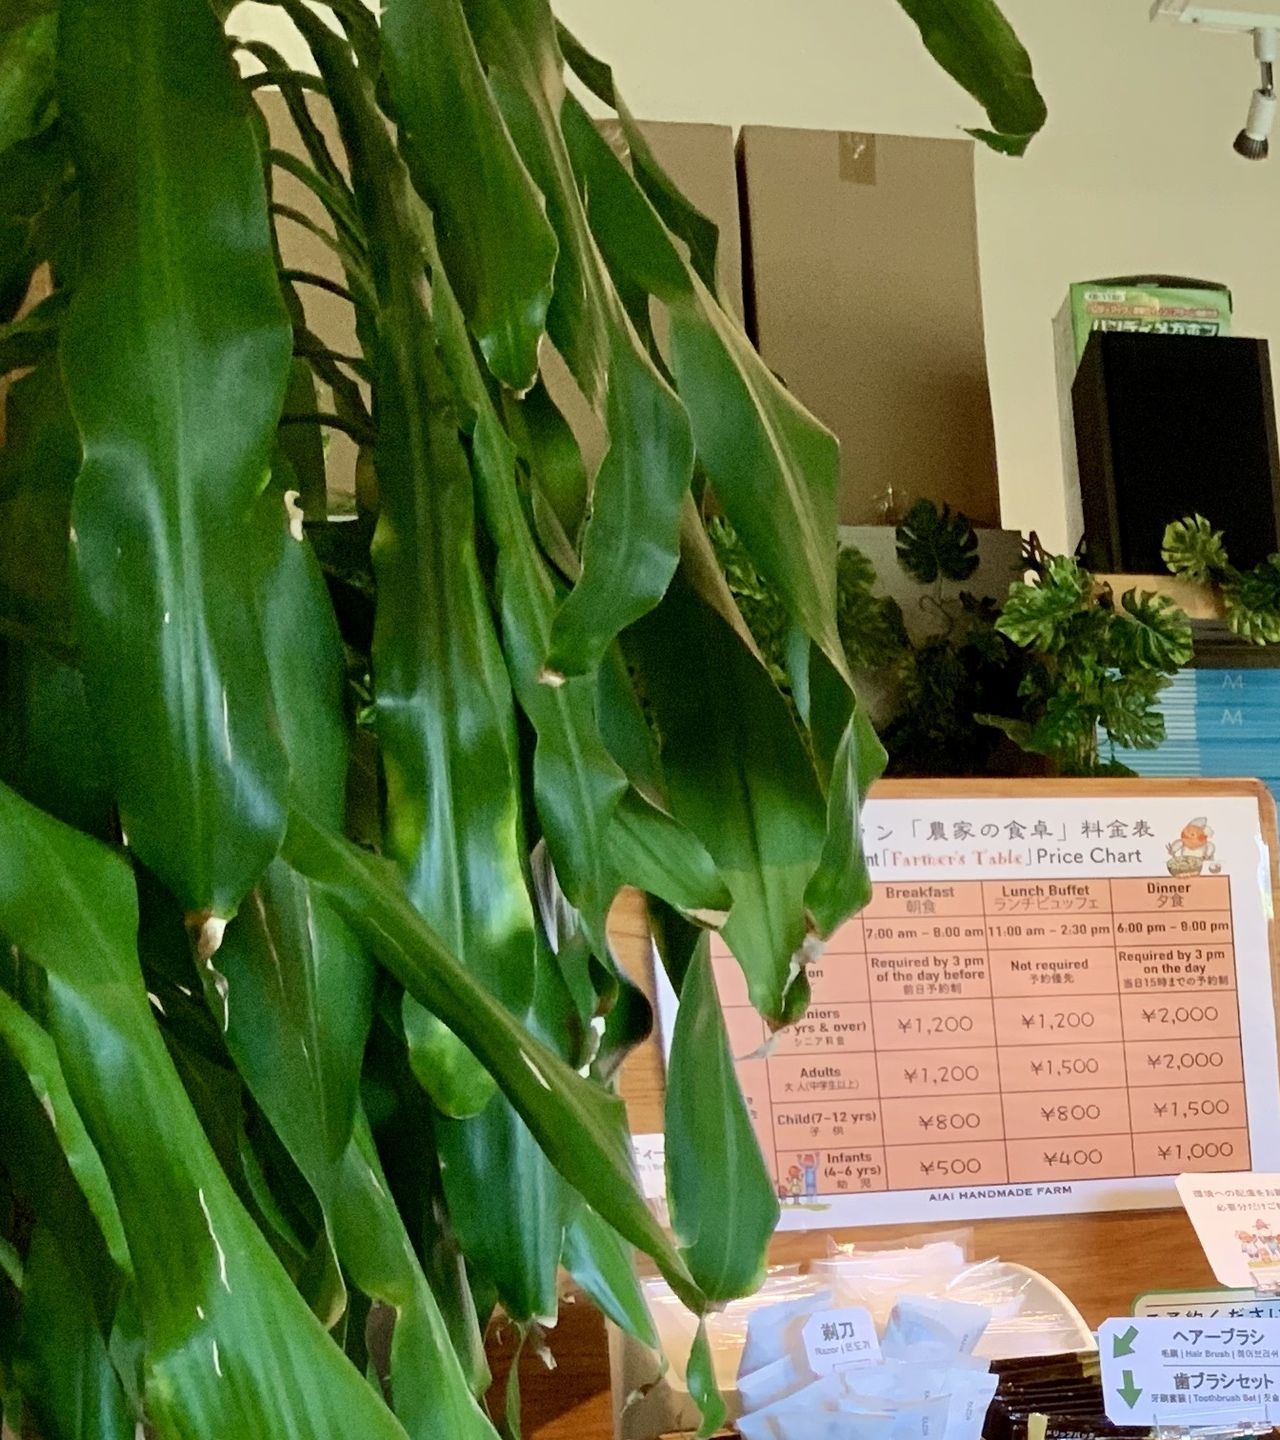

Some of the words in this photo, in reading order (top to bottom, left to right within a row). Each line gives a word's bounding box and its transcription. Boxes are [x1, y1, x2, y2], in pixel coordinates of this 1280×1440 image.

[1222, 674, 1245, 690] A4
[1222, 709, 1244, 725] A4
[1036, 847, 1084, 864] Price
[1090, 846, 1143, 864] Chart
[885, 886, 955, 899] Breakfast
[1002, 884, 1044, 898] Lunch
[1047, 884, 1090, 898] Buffet
[1147, 882, 1192, 895] Dinner
[1157, 894, 1184, 908] 夕食
[865, 928, 893, 940] 7:00
[897, 930, 918, 939] am
[933, 926, 961, 938] 8:00
[964, 928, 984, 937] am
[988, 925, 1022, 937] 11:00
[1025, 927, 1045, 936] am
[1060, 923, 1087, 936] 2:30
[1090, 926, 1110, 937] pm
[1117, 922, 1143, 934] 6:00
[1146, 924, 1166, 936] pm
[1180, 920, 1207, 932] 8:00
[1210, 922, 1229, 934] pm
[871, 956, 930, 970] Required
[933, 955, 949, 970] by
[952, 955, 960, 966] 3
[964, 957, 984, 968] pm
[1118, 949, 1174, 964] Required
[1177, 949, 1192, 962] by
[1195, 948, 1203, 960] 3
[1206, 951, 1225, 962] pm
[1010, 960, 1032, 972] Not
[1035, 958, 1089, 972] required
[1143, 966, 1159, 974] on
[1161, 963, 1181, 974] the
[1184, 963, 1206, 975] day
[876, 971, 888, 983] of
[892, 971, 913, 982] the
[917, 970, 940, 983] day
[943, 968, 985, 980] before
[807, 1009, 840, 1019] niors
[1021, 1011, 1095, 1031] ¥1,200
[1141, 1006, 1219, 1025] ¥2,000
[794, 1025, 815, 1035] yrs
[819, 1022, 829, 1033] &
[833, 1021, 867, 1032] over)
[897, 1015, 973, 1035] ¥1,200
[1030, 1057, 1099, 1077] ¥1,500
[1147, 1051, 1224, 1071] ¥2,000
[800, 1066, 841, 1078] Adults
[904, 1065, 979, 1085] ¥1,200
[1040, 1104, 1101, 1122] ¥800
[1153, 1099, 1230, 1119] ¥1,500
[918, 1113, 981, 1131] ¥800
[827, 1152, 872, 1164] Infants
[1043, 1148, 1103, 1167] ¥400
[1157, 1141, 1234, 1161] ¥1,000
[824, 1165, 853, 1178] (4-6
[856, 1165, 882, 1178] yrs)
[919, 1158, 982, 1176] ¥500
[929, 1192, 955, 1202] AIAI
[959, 1188, 1033, 1200] HANDMADE
[1036, 1185, 1072, 1196] FARM
[1173, 1327, 1265, 1346] ヘアーブラシ
[1185, 1350, 1202, 1358] Hair
[1205, 1350, 1231, 1358] Brush
[1174, 1371, 1274, 1390] 歯ブラシセット
[1193, 1393, 1241, 1402] Toothbrush
